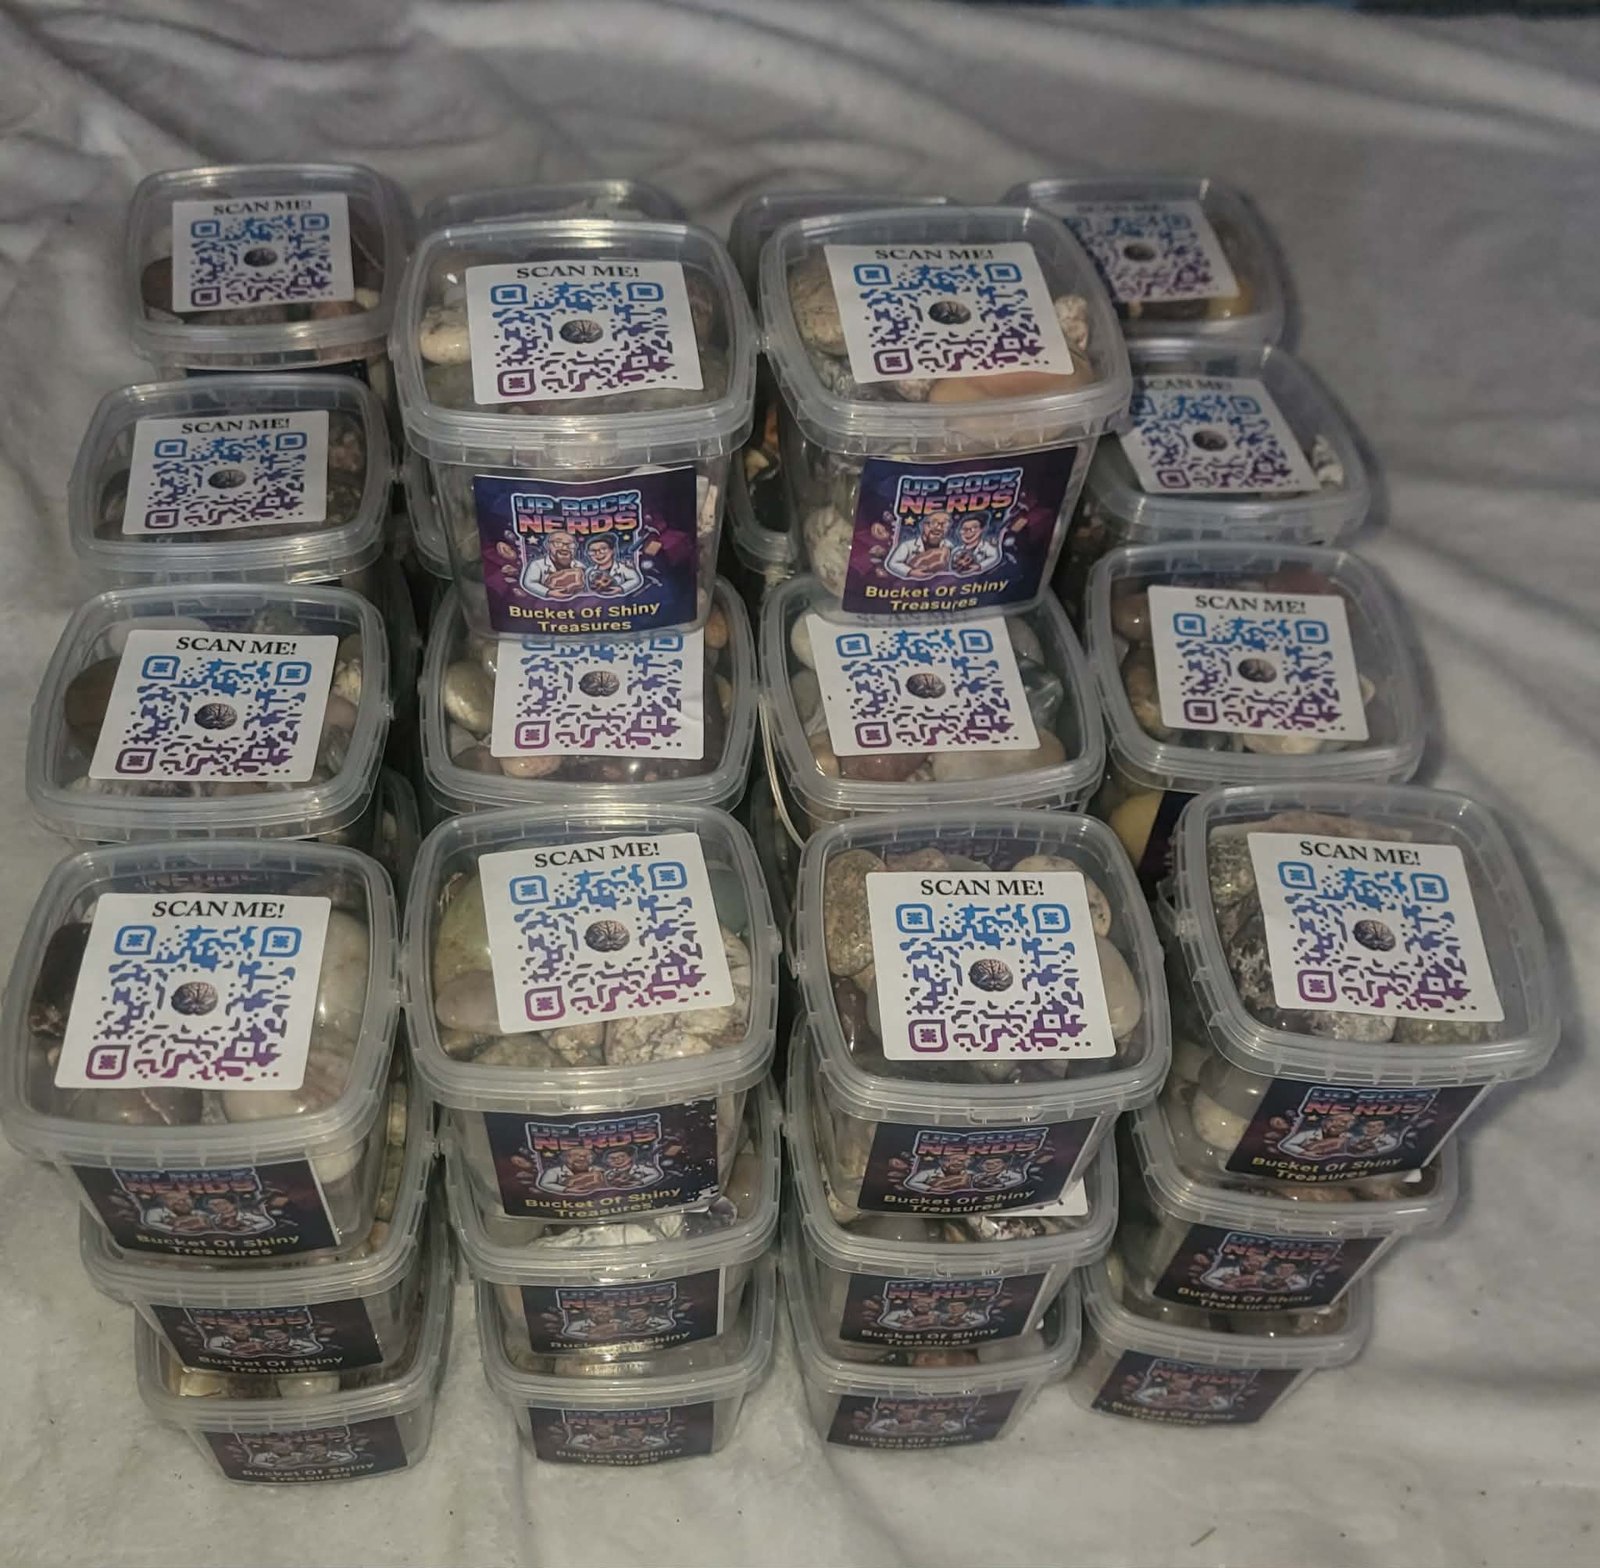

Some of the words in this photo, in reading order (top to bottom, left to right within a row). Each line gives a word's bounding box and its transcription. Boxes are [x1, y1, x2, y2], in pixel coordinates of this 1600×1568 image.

[213, 200, 269, 215] SCAN
[274, 199, 312, 211] ME!
[875, 249, 943, 260] SCAN
[949, 249, 994, 260] ME!
[516, 265, 586, 279] SCAN
[593, 265, 640, 278] ME!
[181, 420, 244, 434] SCAN
[248, 418, 290, 430] ME!
[903, 480, 940, 496] UP
[946, 471, 1021, 495] ROCK
[515, 495, 553, 515] UP
[561, 491, 639, 516] ROCK
[900, 489, 1014, 513] NERDS
[518, 511, 638, 534] NERDS
[865, 585, 930, 599] Bucket
[935, 585, 956, 597] Of
[960, 579, 1009, 595] Shiny
[508, 605, 575, 619] Bucket
[580, 606, 602, 618] Of
[608, 602, 660, 616] Shiny
[890, 597, 978, 611] Treasures
[1195, 594, 1258, 611] SCAN
[1264, 598, 1306, 614] ME!
[537, 620, 632, 632] Treasures
[176, 636, 246, 652] SCAN
[250, 640, 297, 656] ME!
[534, 846, 605, 868] SCAN
[612, 842, 660, 860] ME!
[1299, 840, 1368, 860] SCAN
[1374, 847, 1422, 866] ME!
[921, 879, 990, 896] SCAN
[997, 879, 1044, 897] ME!
[152, 900, 228, 918] SCAN
[231, 901, 285, 919] ME!
[1304, 1102, 1424, 1116] NERDS
[533, 1131, 657, 1151] NERDS
[1251, 1157, 1319, 1172] Bucket
[1324, 1162, 1346, 1172] Of
[1352, 1159, 1400, 1169] Shiny
[1276, 1169, 1368, 1182] Treasures
[525, 1198, 594, 1210] Bucket
[600, 1197, 621, 1207] Of
[628, 1187, 681, 1201] Shiny
[883, 1194, 951, 1206] Bucket
[956, 1196, 979, 1205] Of
[984, 1189, 1036, 1202] Shiny
[552, 1203, 655, 1218] Treasures
[910, 1202, 1003, 1214] Treasures
[136, 1234, 207, 1247] Bucket
[213, 1239, 237, 1248] Of
[242, 1235, 300, 1247] Shiny
[174, 1247, 273, 1257] Treasures
[1177, 1287, 1237, 1302] Bucket
[1243, 1294, 1263, 1303] Of
[861, 1329, 922, 1340] Bucket
[266, 1360, 288, 1368] Of
[292, 1356, 344, 1367] Shiny
